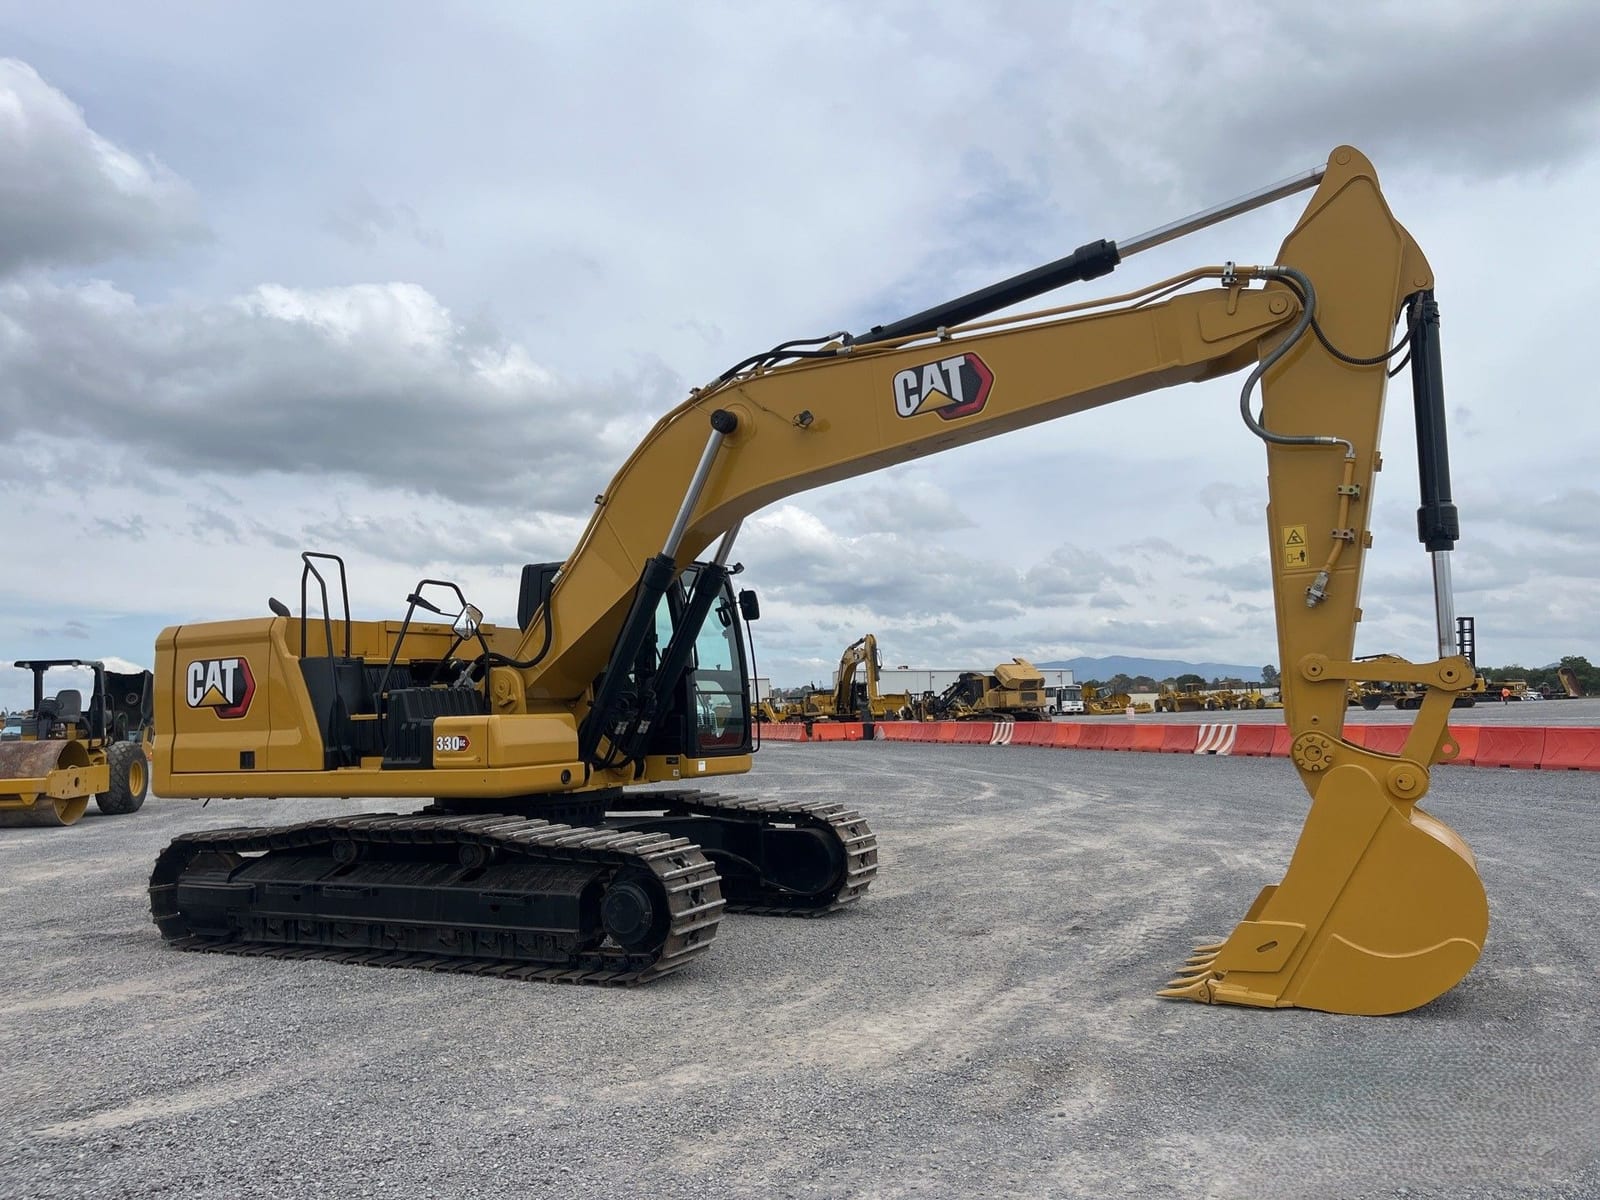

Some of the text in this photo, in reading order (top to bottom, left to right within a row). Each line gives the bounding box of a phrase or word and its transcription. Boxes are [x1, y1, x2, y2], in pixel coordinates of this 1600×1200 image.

[893, 355, 966, 417] CAT
[187, 659, 239, 707] CAT
[436, 736, 459, 751] 330
